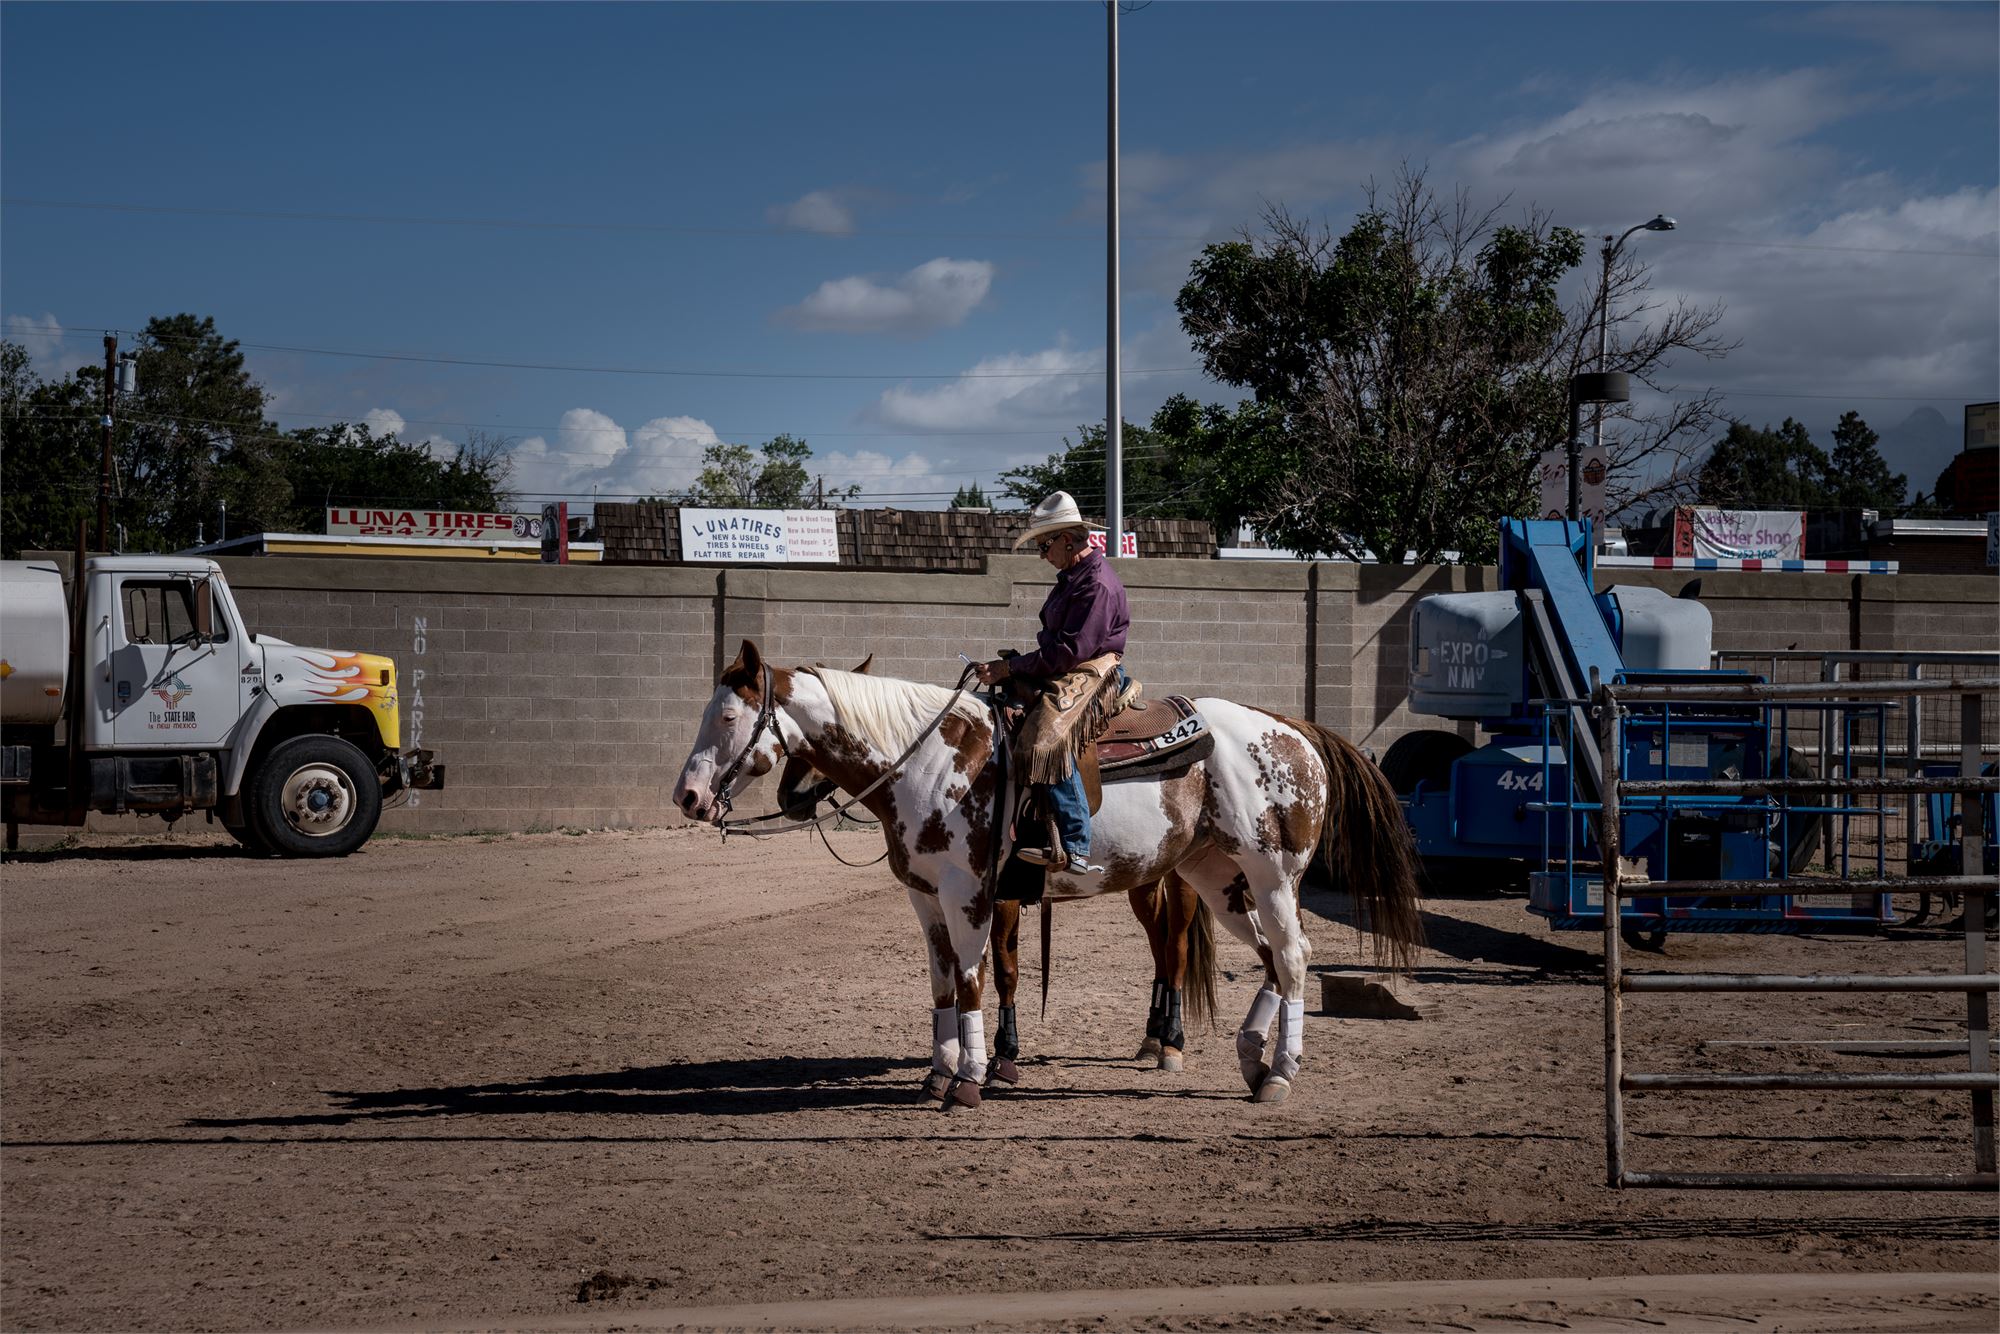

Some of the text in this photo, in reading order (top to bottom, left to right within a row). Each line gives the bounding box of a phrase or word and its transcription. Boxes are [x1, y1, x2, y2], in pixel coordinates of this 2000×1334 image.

[331, 509, 512, 530] LUNA TIRES
[359, 525, 484, 538] 254-7717
[712, 533, 729, 541] NEW
[739, 534, 760, 542] USED
[1706, 530, 1792, 546] Barber Shop
[693, 550, 712, 558] FLAT
[738, 551, 766, 559] REPAIR
[706, 541, 729, 549] TIRES
[738, 542, 770, 551] WHEELS
[414, 617, 428, 655] NO
[1440, 640, 1488, 666] EXPO
[149, 711, 196, 723] The STATE FAIR
[408, 669, 426, 807] PARKIG
[1161, 719, 1203, 745] 842
[1496, 769, 1545, 792] 4x4
